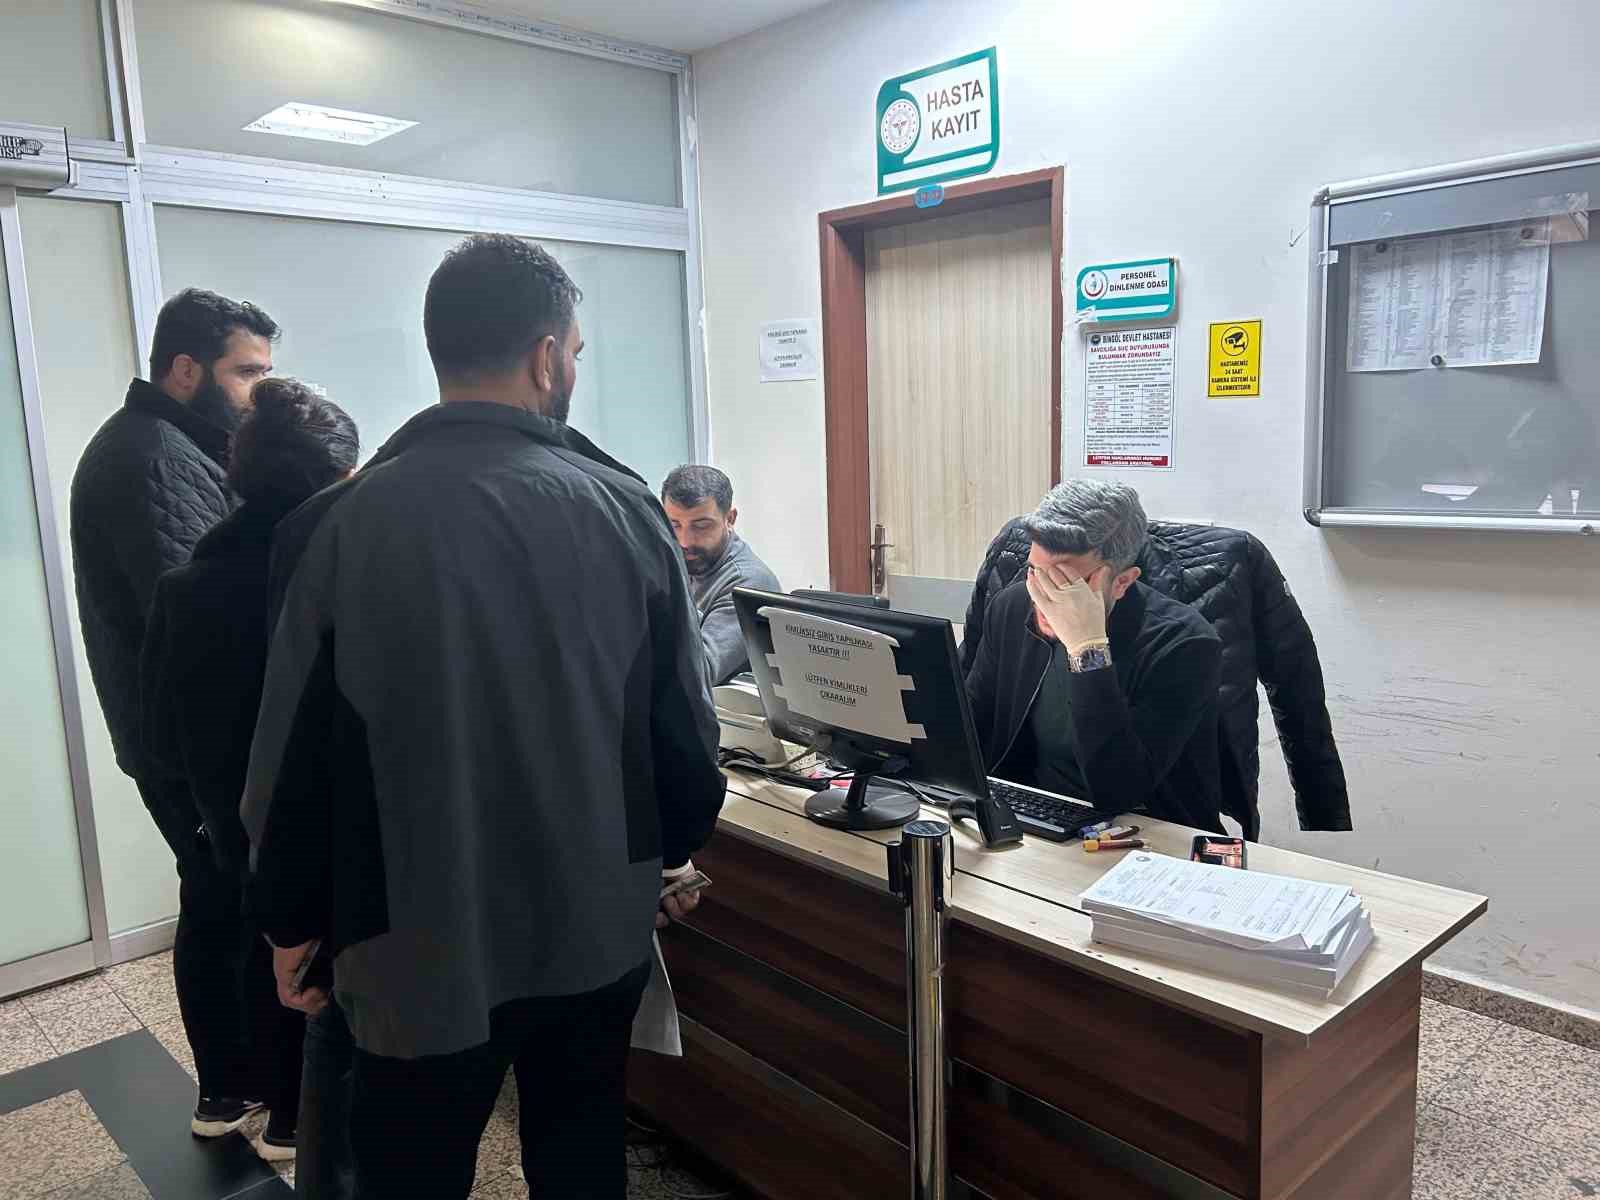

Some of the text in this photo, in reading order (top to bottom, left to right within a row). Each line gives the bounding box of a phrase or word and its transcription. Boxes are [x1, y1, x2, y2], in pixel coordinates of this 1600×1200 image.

[927, 79, 984, 113] HASTA
[931, 109, 981, 141] KAYIT
[1120, 271, 1157, 281] PERSONEL
[1146, 280, 1168, 289] ODASI
[807, 643, 840, 657] YASAKTIR
